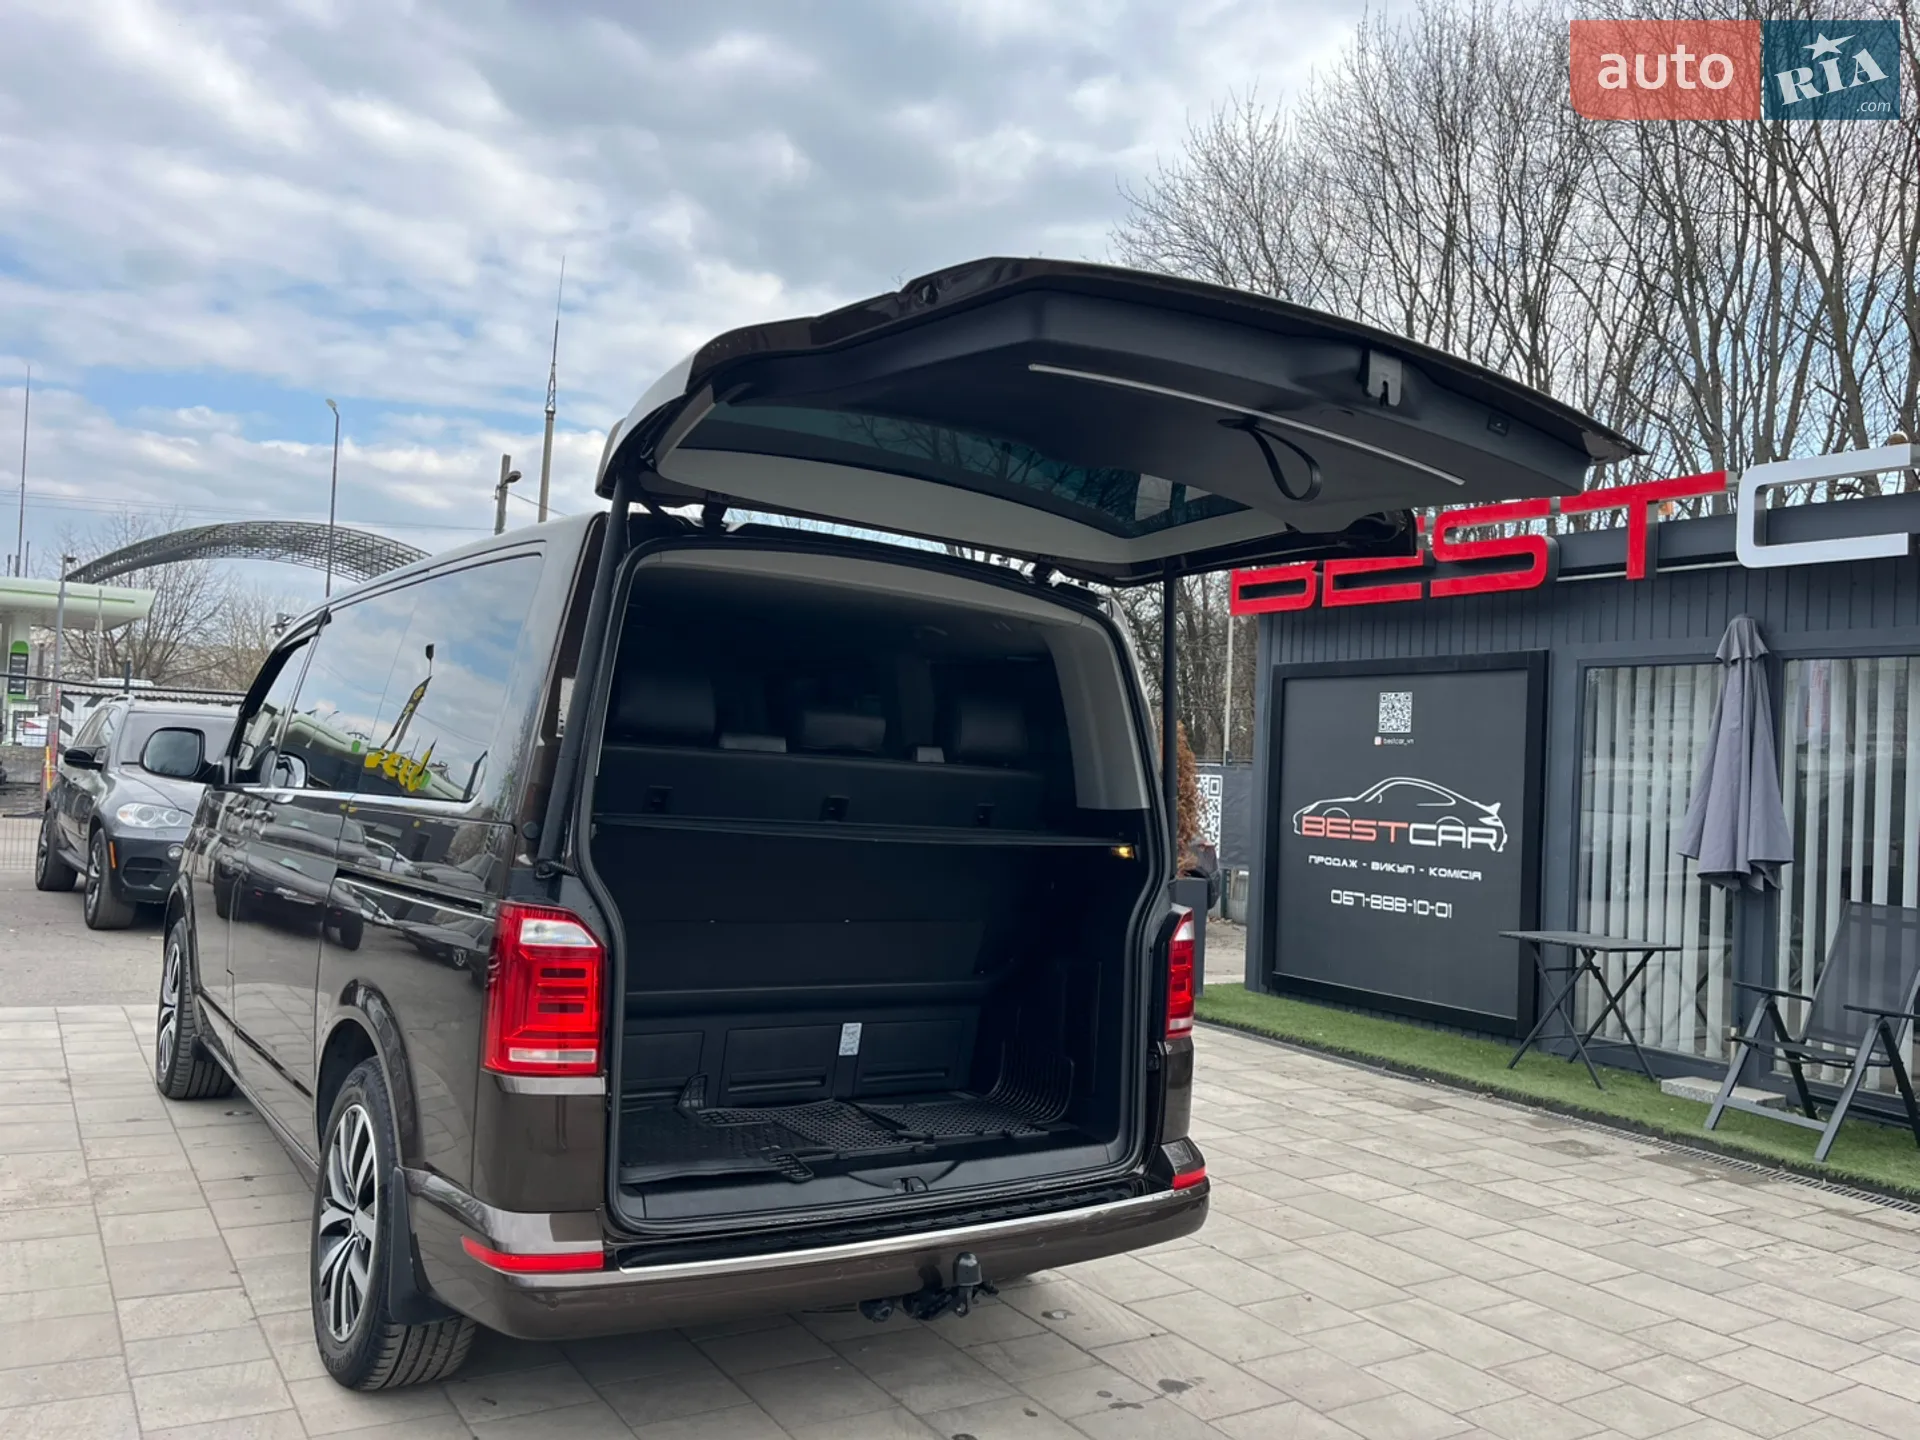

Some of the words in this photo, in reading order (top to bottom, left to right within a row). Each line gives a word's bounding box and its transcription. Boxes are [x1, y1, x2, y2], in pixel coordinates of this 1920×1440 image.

[1302, 816, 1498, 851] BESTCAR
[1308, 855, 1358, 868] ПРОДАЖ
[1371, 861, 1415, 874] ВИКУП
[1429, 867, 1482, 881] КОМІСІЯ
[1331, 889, 1452, 918] 067-888-10-01
